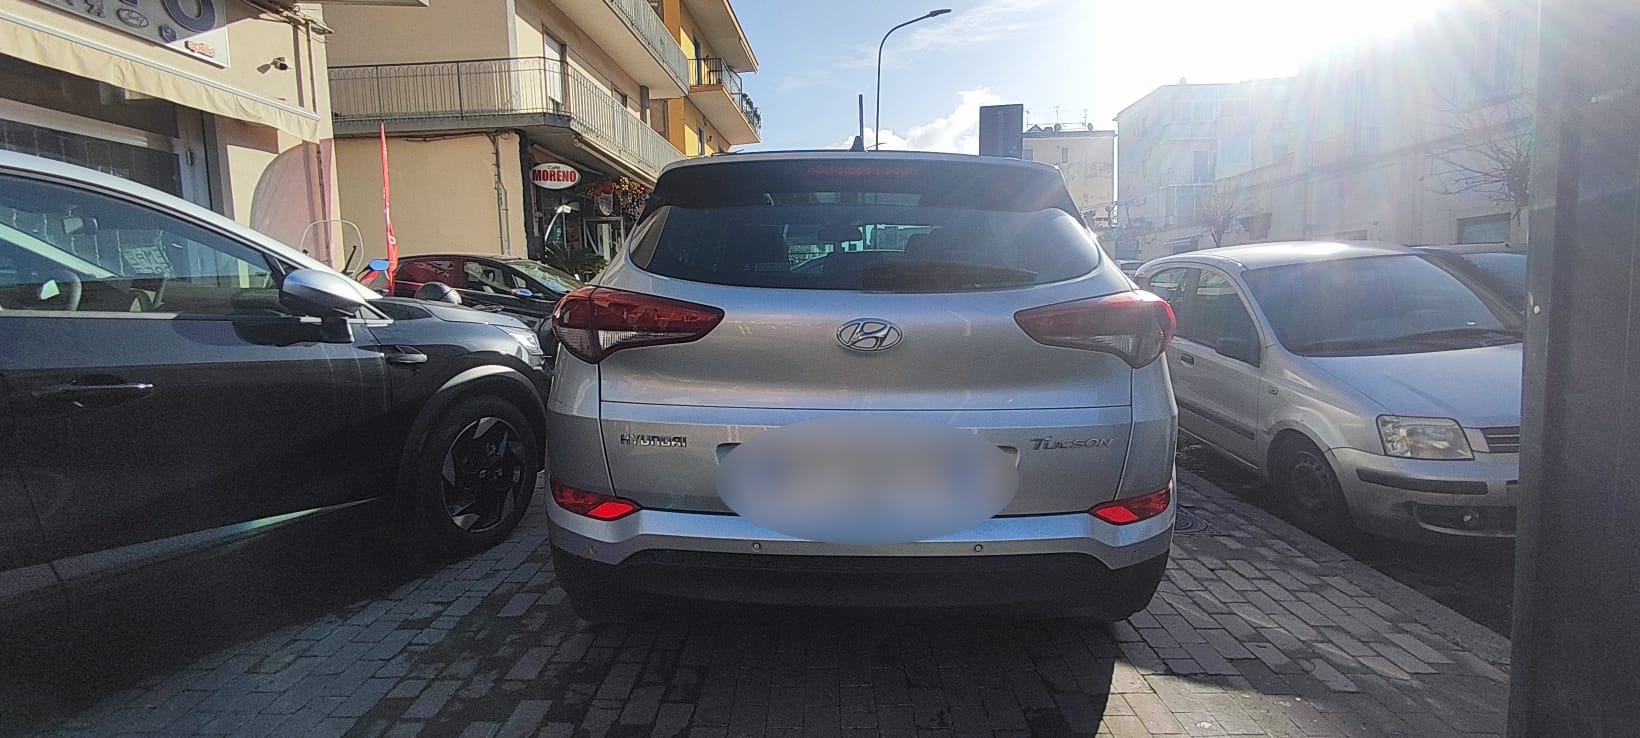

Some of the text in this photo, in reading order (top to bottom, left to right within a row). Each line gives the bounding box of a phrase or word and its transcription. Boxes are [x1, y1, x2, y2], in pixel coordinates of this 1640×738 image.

[532, 169, 577, 183] MORENO
[620, 433, 688, 448] HYUNDAI
[1030, 435, 1114, 450] TUCSON
